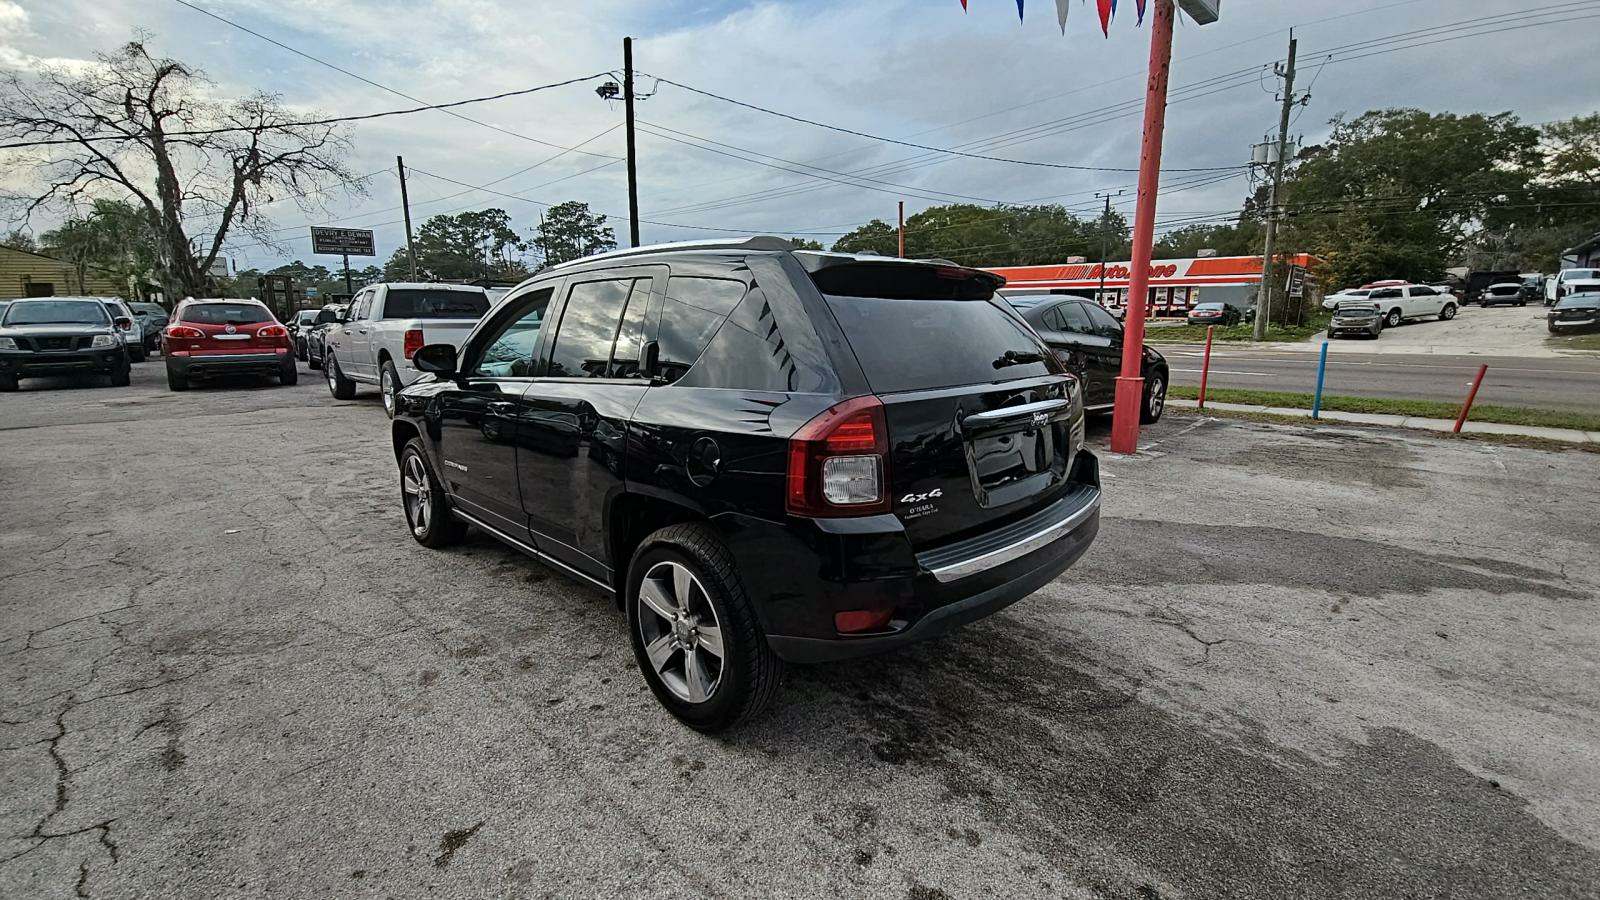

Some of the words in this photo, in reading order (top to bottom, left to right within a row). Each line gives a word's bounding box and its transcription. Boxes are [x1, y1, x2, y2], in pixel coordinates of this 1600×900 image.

[347, 231, 371, 239] DEWAN
[1088, 264, 1178, 279] Autone
[1031, 412, 1048, 426] Jeep
[900, 488, 943, 503] 4x4
